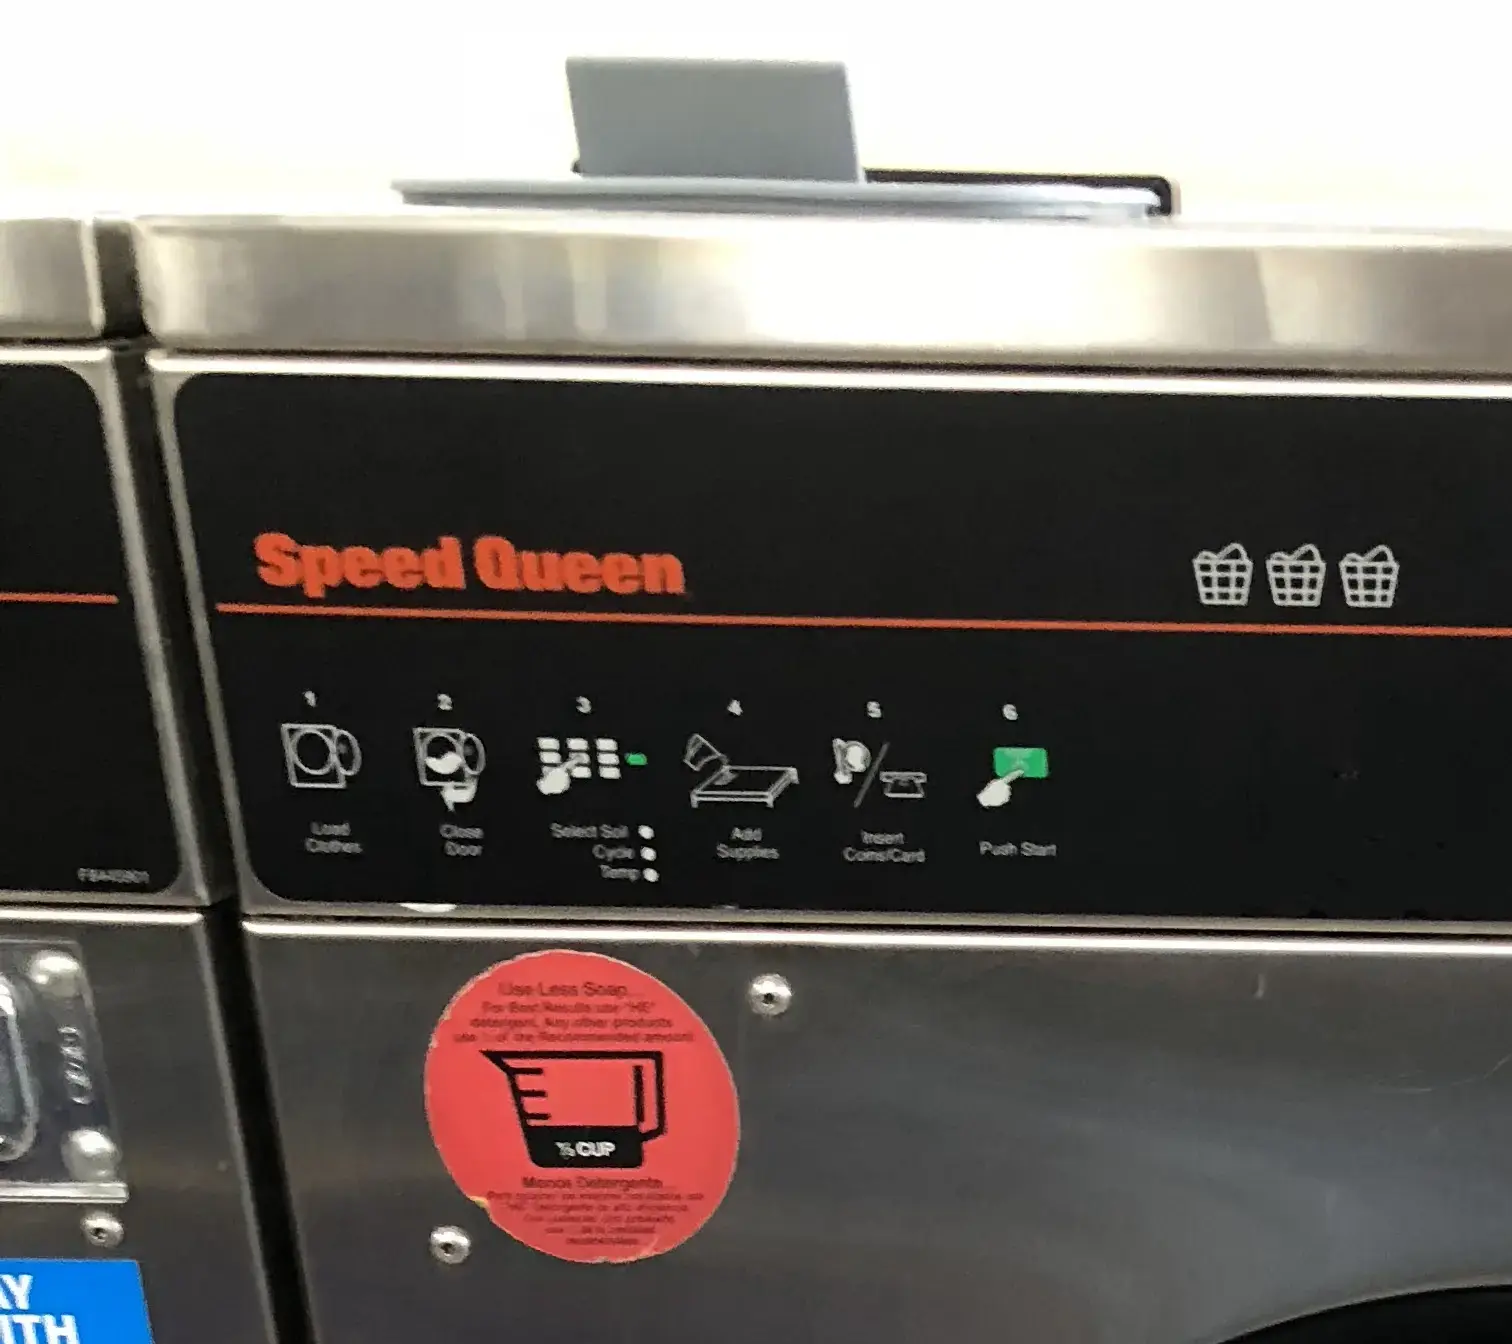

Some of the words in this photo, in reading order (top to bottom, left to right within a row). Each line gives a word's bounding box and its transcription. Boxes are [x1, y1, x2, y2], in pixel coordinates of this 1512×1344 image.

[253, 532, 466, 598] Speed
[474, 535, 688, 595] Queen
[437, 693, 453, 711] 2
[576, 696, 592, 714] 3
[727, 700, 743, 716] 4
[576, 1141, 616, 1157] CUP
